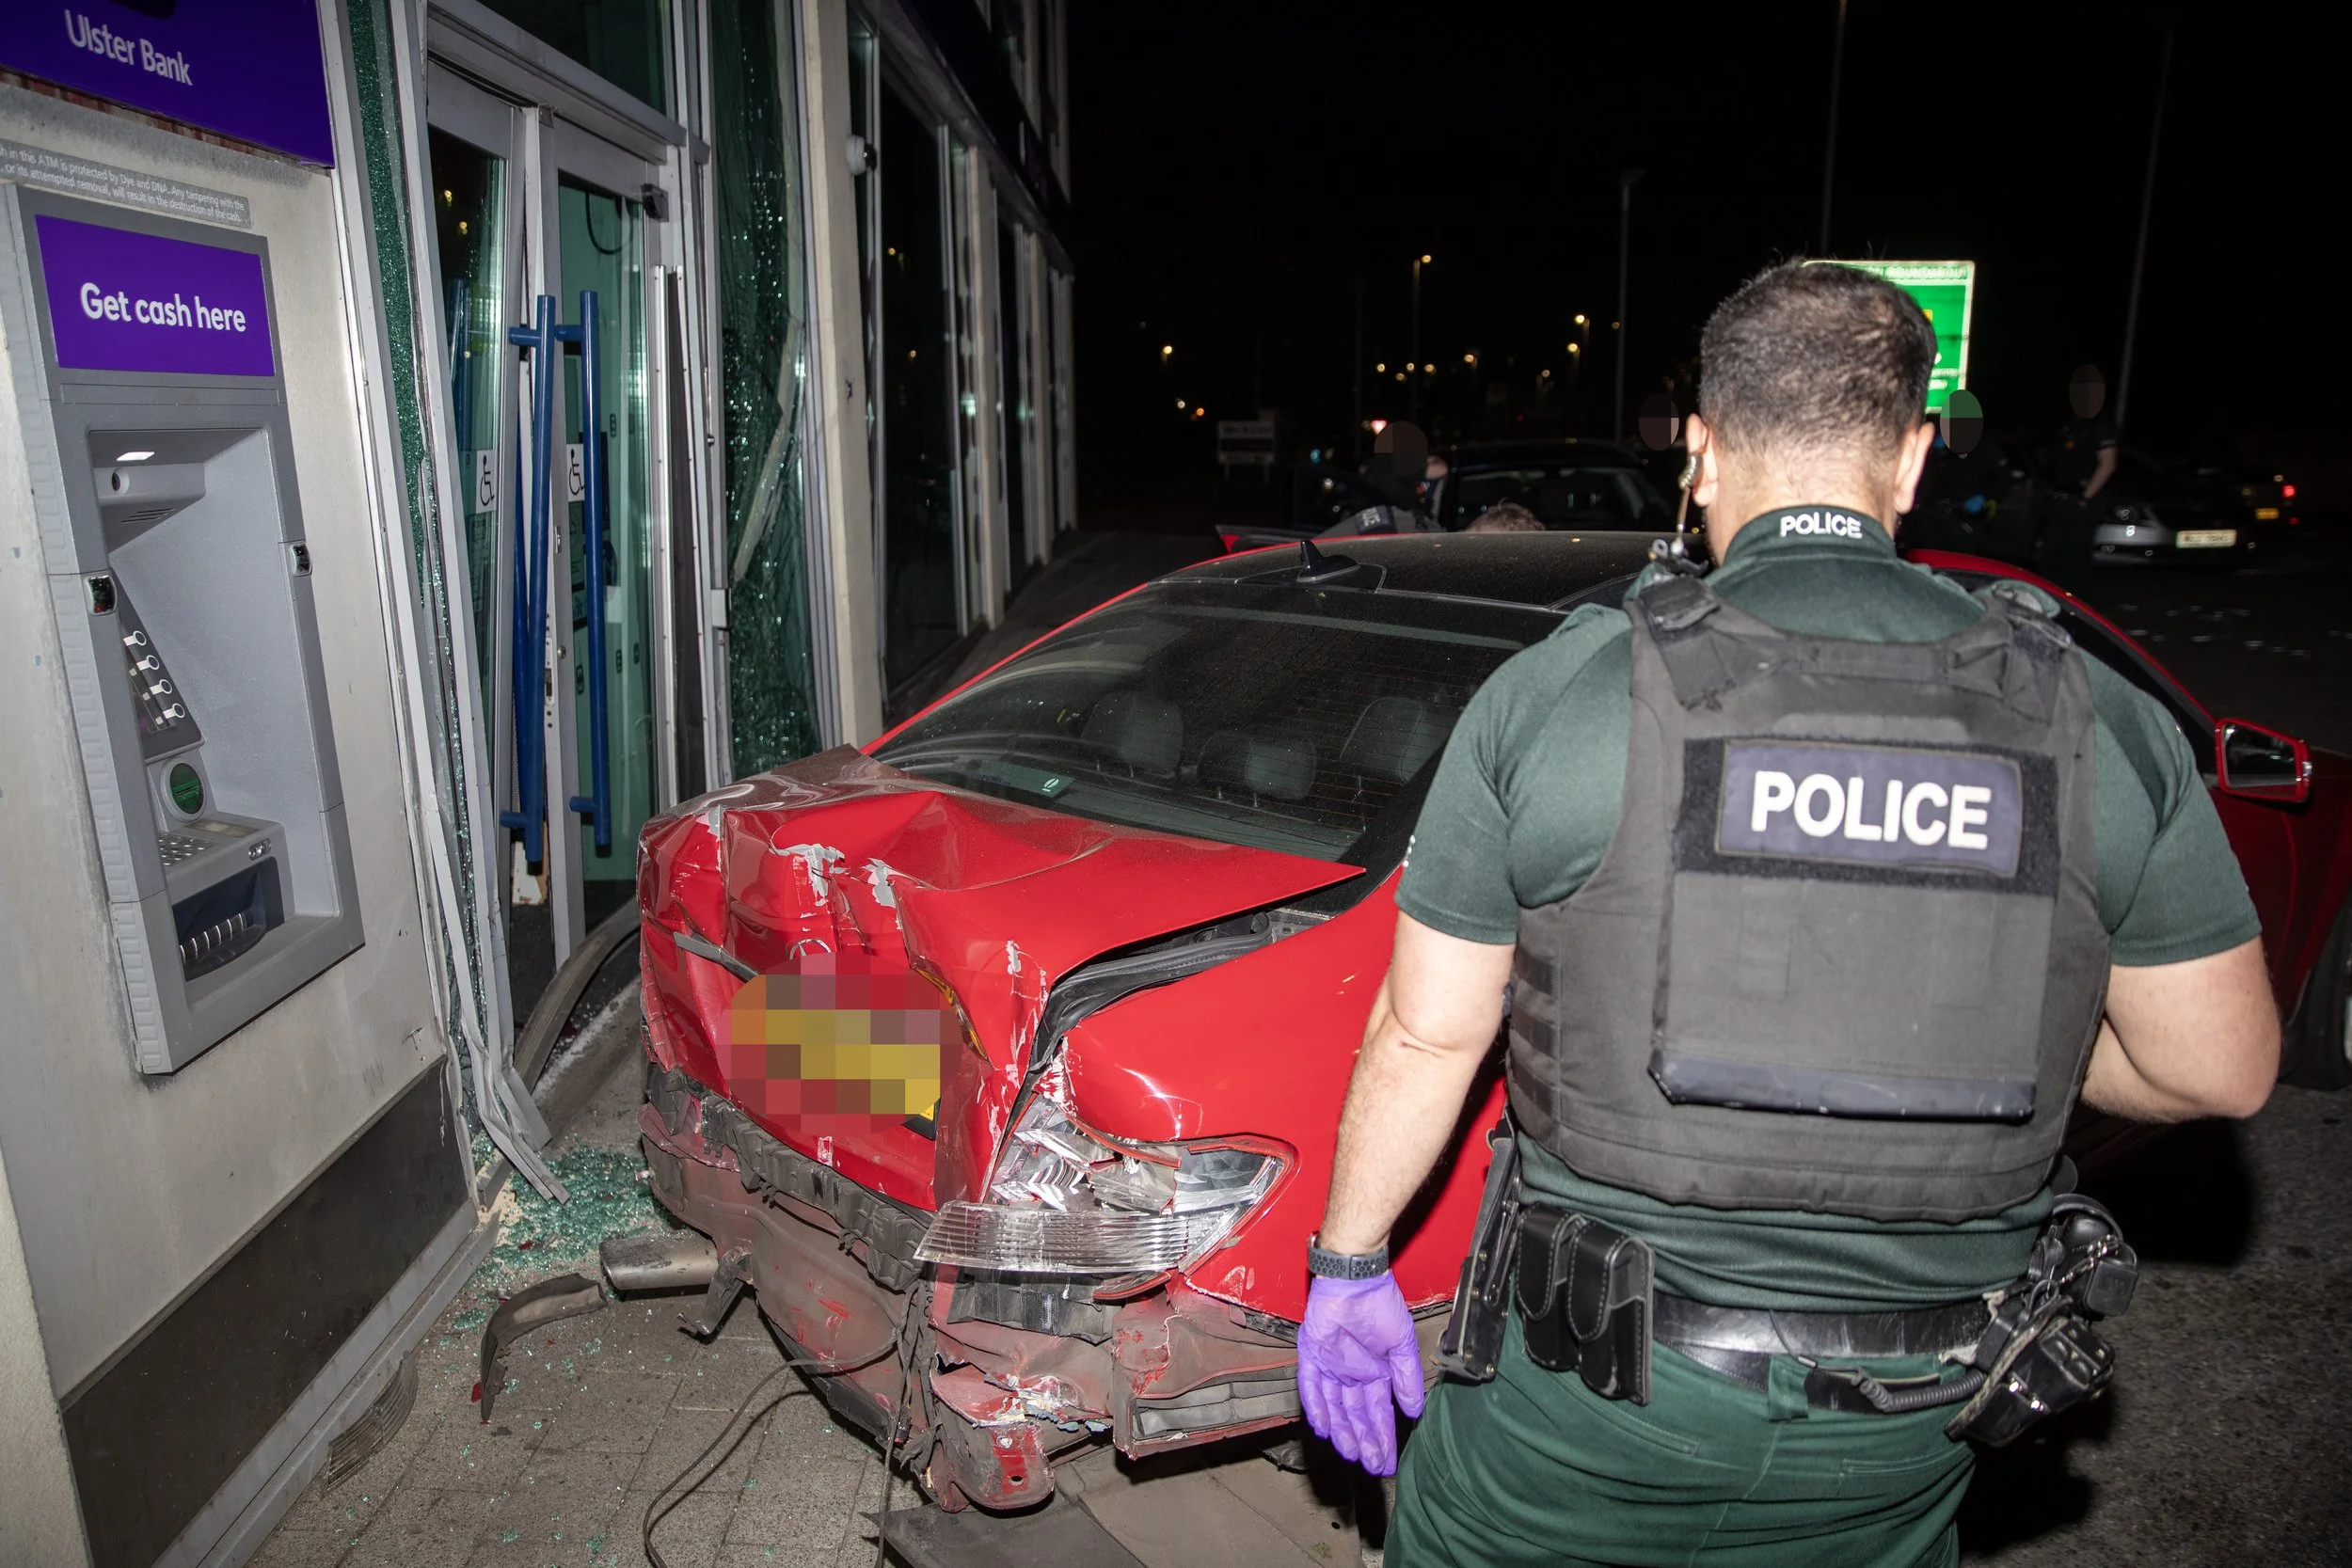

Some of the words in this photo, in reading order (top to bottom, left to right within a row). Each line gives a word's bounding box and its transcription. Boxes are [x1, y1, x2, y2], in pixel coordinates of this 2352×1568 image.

[64, 8, 135, 66] Ulster
[139, 38, 193, 86] Bank
[5, 164, 16, 174] or
[17, 164, 29, 177] its
[30, 169, 75, 187] attempted
[77, 180, 111, 197] removal,
[113, 185, 126, 198] will
[126, 191, 148, 203] result
[148, 194, 156, 204] in
[156, 195, 168, 207] the
[169, 198, 207, 215] destruction
[206, 206, 215, 217] of
[215, 208, 226, 219] the
[19, 150, 37, 165] this
[39, 153, 59, 168] ATM
[60, 159, 68, 171] is
[69, 164, 108, 181] protected
[109, 170, 119, 185] by
[120, 173, 135, 188] Dye
[136, 179, 151, 190] and
[171, 185, 185, 199] Any
[185, 190, 219, 207] tampering
[219, 198, 234, 209] with
[234, 198, 245, 211] the
[80, 282, 132, 322] Get
[135, 293, 192, 327] cash
[194, 295, 246, 332] here
[1780, 512, 1863, 539] POLICE
[1751, 770, 1992, 850] POLICE
